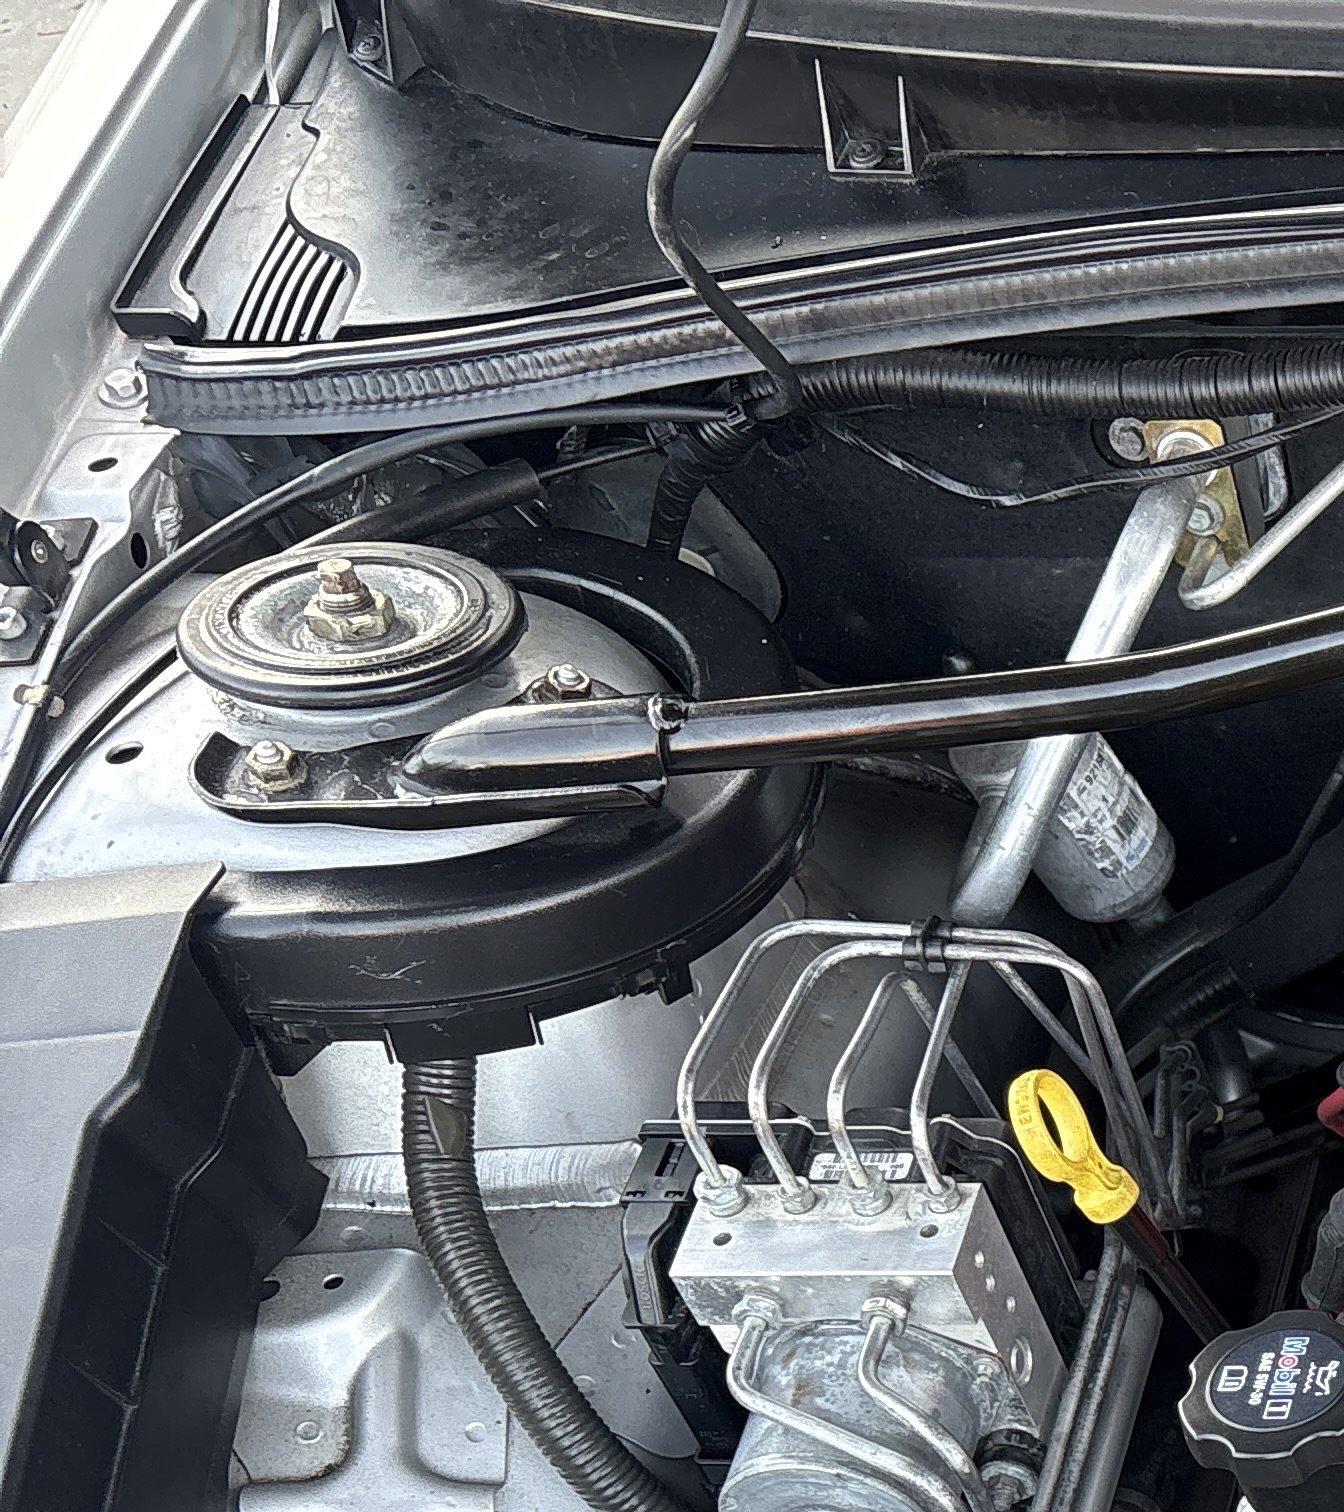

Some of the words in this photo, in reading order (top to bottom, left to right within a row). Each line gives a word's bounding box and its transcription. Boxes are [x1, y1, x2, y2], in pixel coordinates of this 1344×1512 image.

[1258, 1352, 1276, 1372] SAE
[1268, 1336, 1310, 1396] Mobil
[1248, 1373, 1270, 1405] 5W-30
